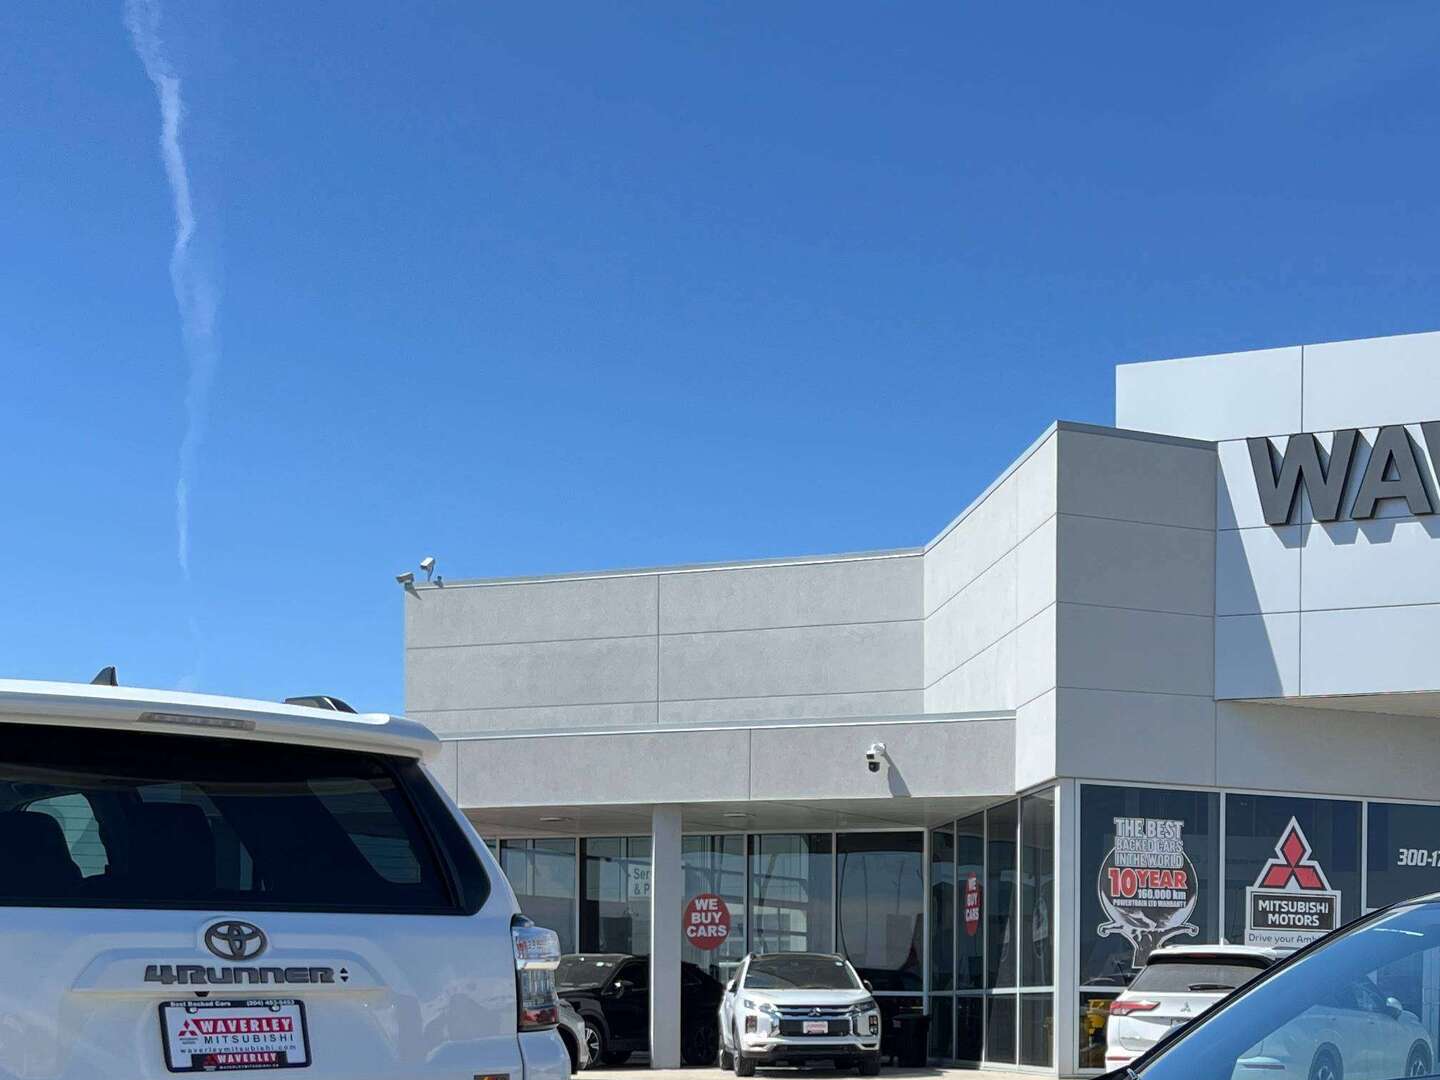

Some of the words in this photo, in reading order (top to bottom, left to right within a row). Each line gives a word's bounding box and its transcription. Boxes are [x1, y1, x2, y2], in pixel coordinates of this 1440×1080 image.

[1114, 817, 1145, 838] THE
[1146, 819, 1184, 839] BEST
[1115, 838, 1157, 853] BACKED
[1157, 838, 1183, 853] CARS
[1115, 853, 1125, 866] IN
[1125, 853, 1146, 866] THE
[1147, 853, 1184, 868] WORLD
[967, 877, 977, 890] WE
[1108, 867, 1137, 898] 10
[1135, 869, 1188, 890] YEAR
[634, 884, 641, 895] &
[1172, 889, 1186, 900] km
[695, 898, 718, 910] WE
[966, 892, 978, 907] BUY
[1257, 899, 1329, 914] MITSUBISHI
[691, 912, 722, 924] BUY
[965, 907, 980, 921] CARS
[1267, 914, 1320, 927] MOTORS
[686, 925, 727, 937] CARS
[1248, 933, 1272, 943] Drive
[1274, 935, 1294, 945] your
[1296, 935, 1318, 943] Amb
[200, 1018, 291, 1033] WAVERLEY
[204, 1034, 294, 1044] MITSUBISHI
[180, 1044, 297, 1053] waverleymitsubishi.com
[217, 1053, 277, 1063] WAVERLEY
